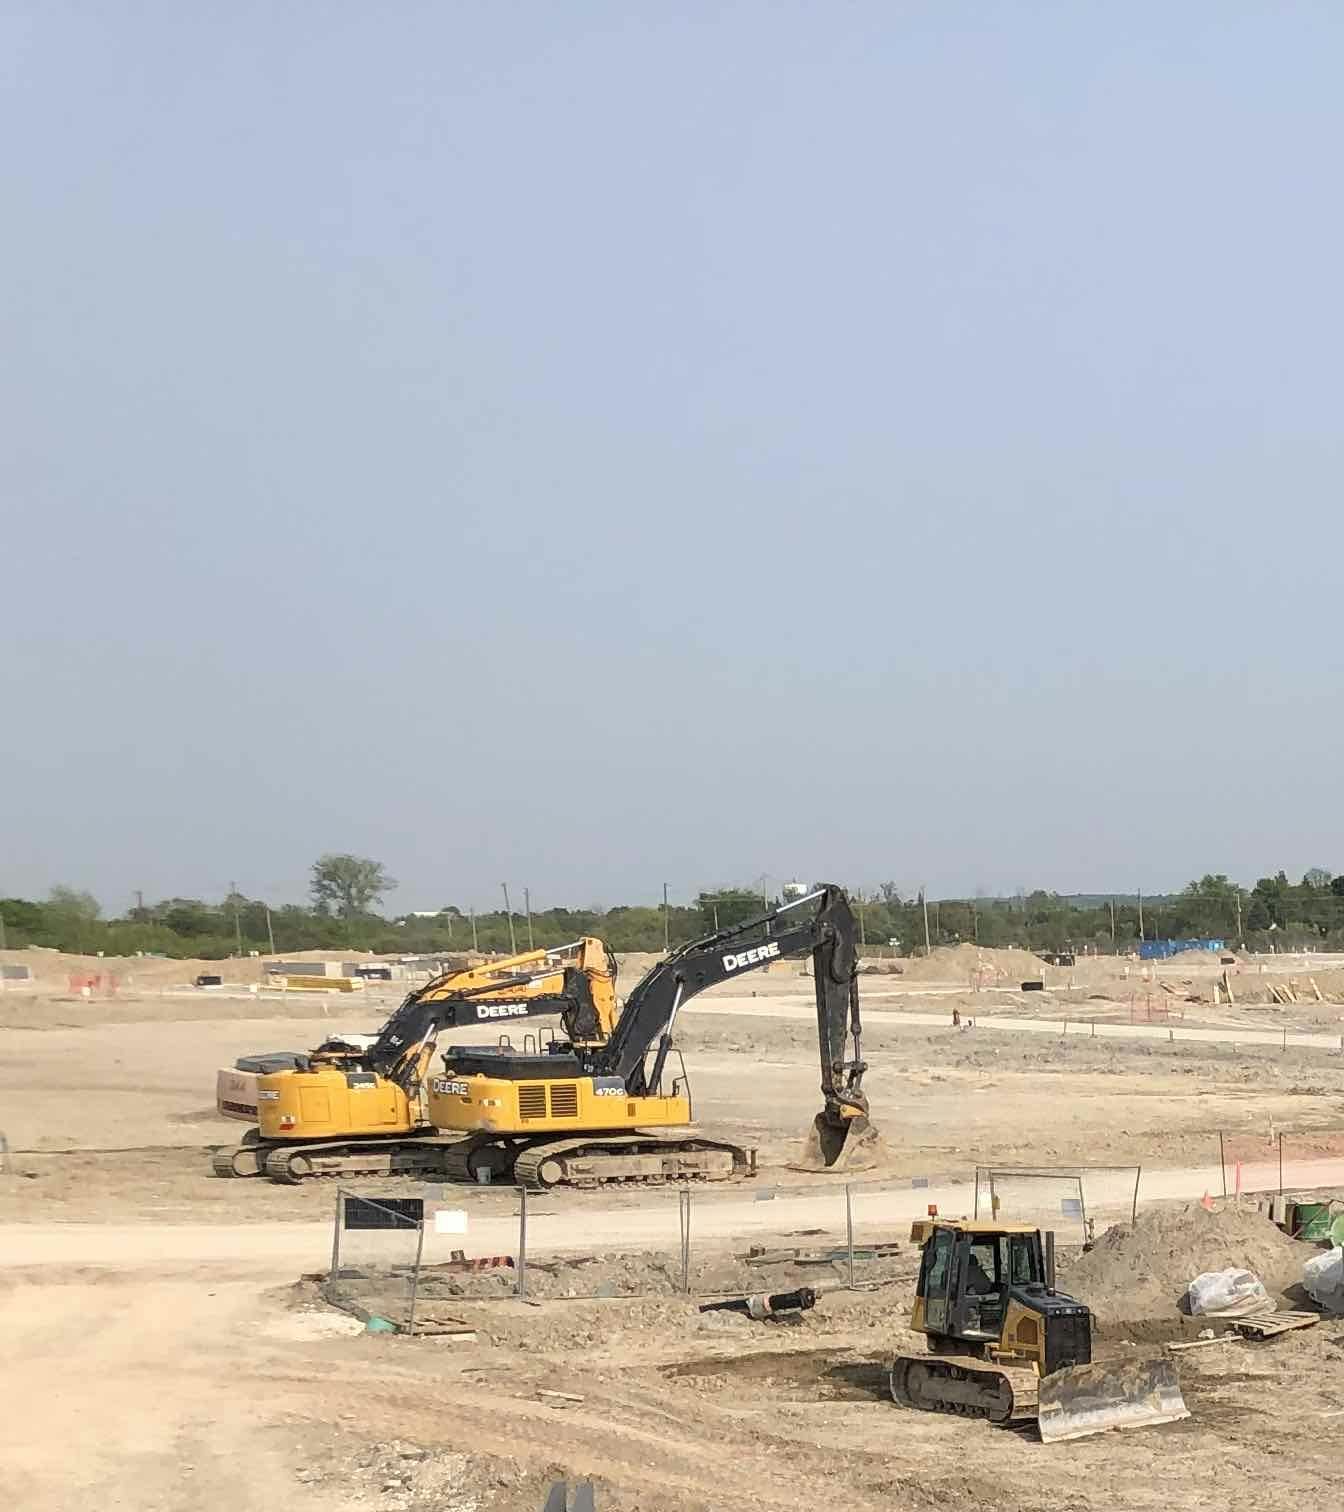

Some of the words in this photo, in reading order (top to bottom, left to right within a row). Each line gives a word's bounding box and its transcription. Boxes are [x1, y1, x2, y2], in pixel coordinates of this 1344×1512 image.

[722, 941, 781, 972] DEERE
[476, 1003, 529, 1019] DEERE
[432, 1078, 469, 1096] DEERE
